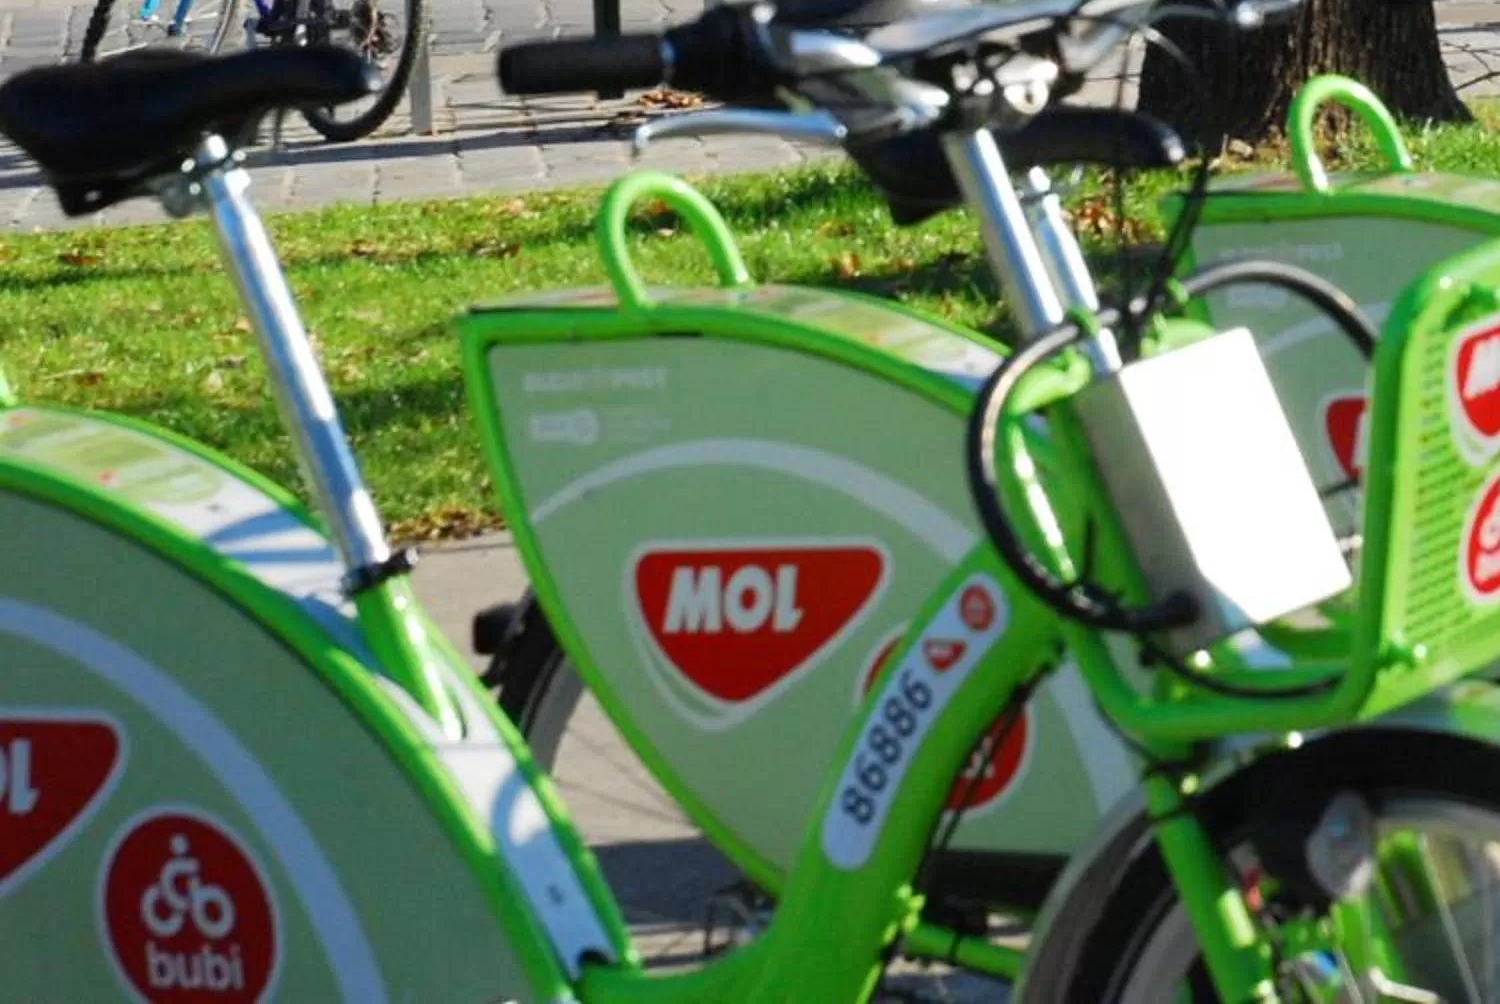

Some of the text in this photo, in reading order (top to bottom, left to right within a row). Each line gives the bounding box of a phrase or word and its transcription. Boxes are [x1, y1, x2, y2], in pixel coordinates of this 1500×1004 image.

[662, 564, 805, 634] MOL
[840, 667, 934, 826] 86886
[144, 940, 244, 990] bubi
